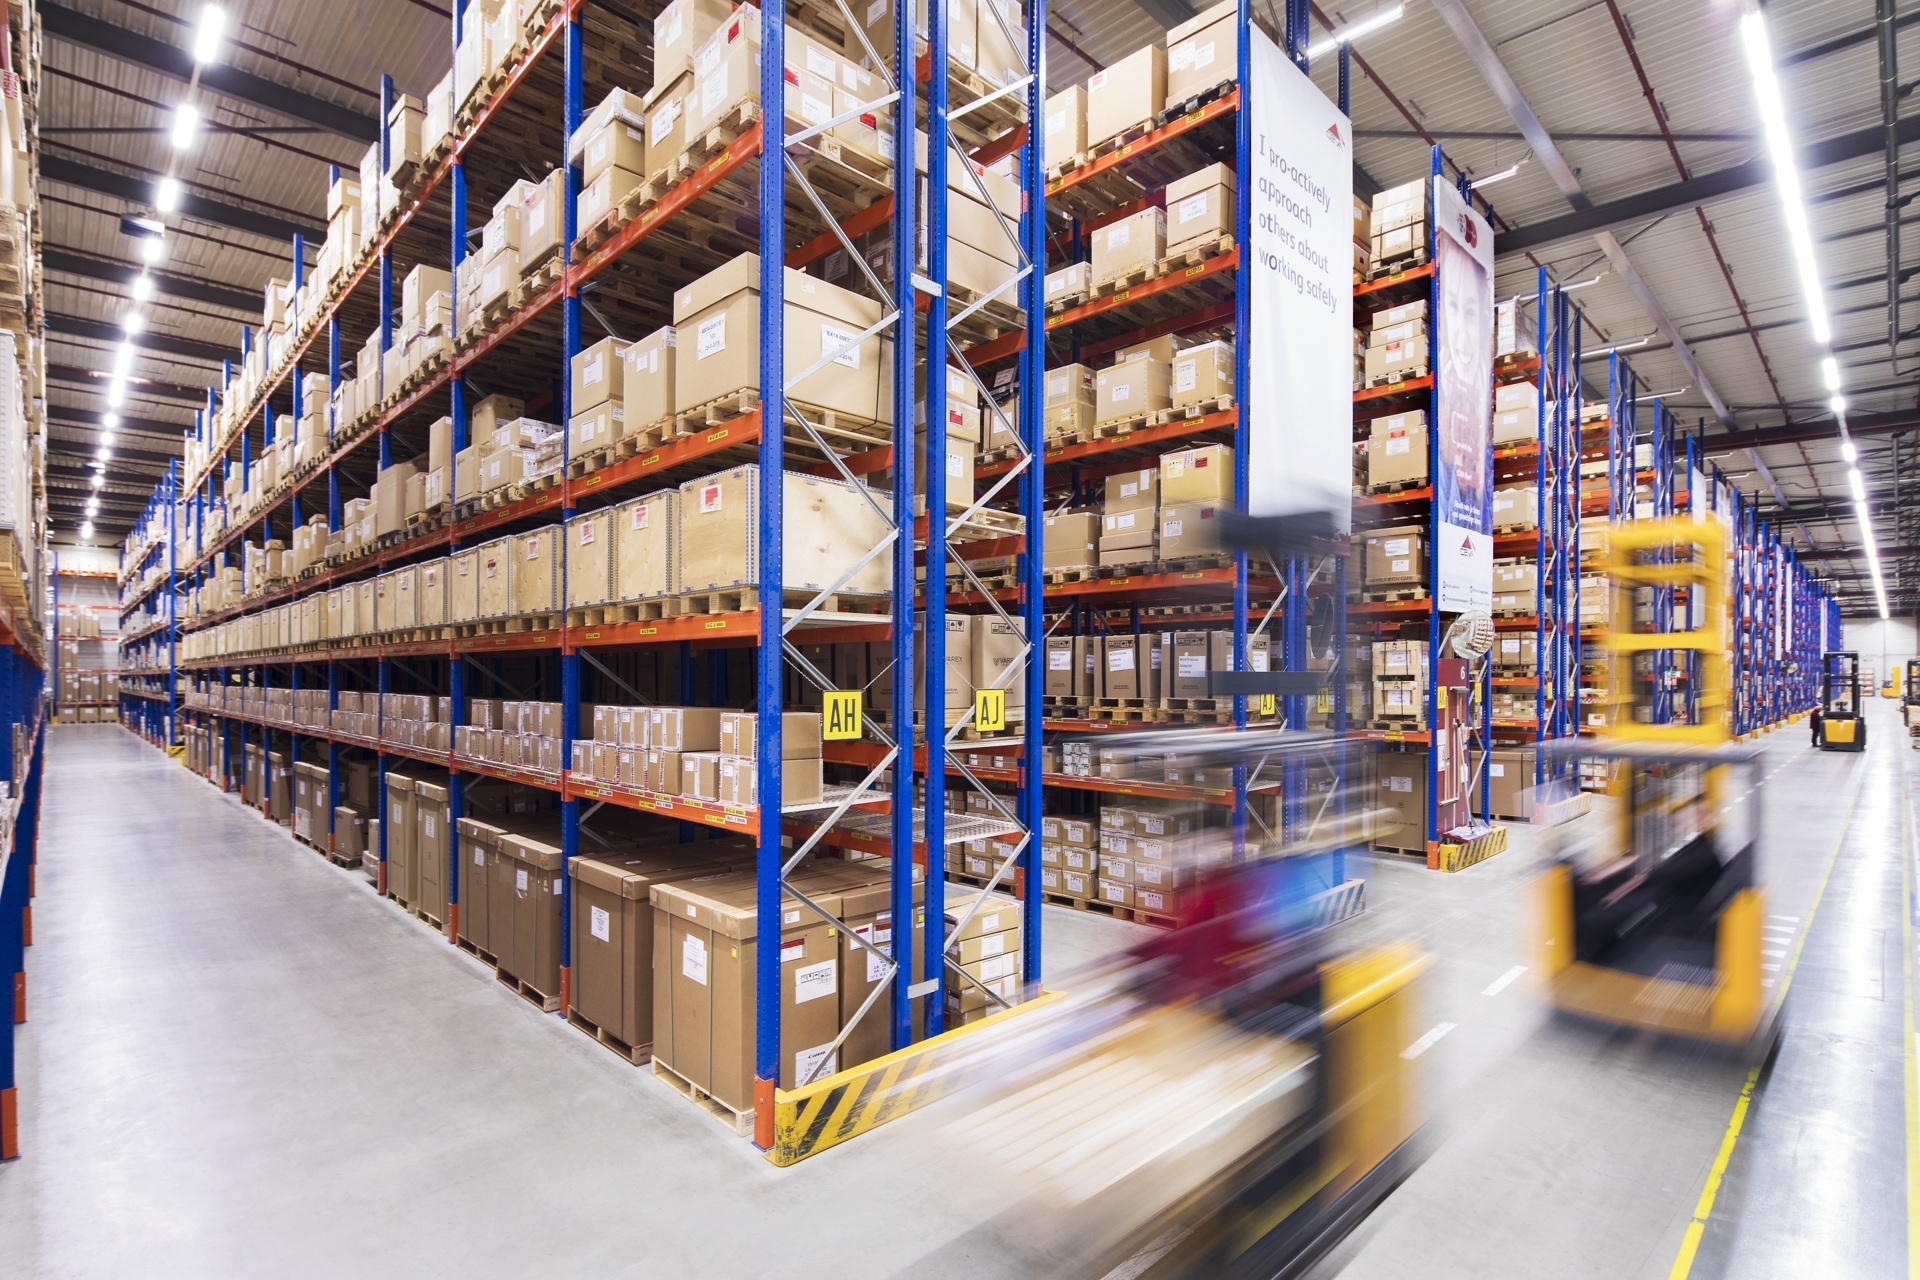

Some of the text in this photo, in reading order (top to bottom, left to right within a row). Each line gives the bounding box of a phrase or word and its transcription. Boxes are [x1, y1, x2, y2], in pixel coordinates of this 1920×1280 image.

[1259, 134, 1331, 213] I pro-actively
[1258, 176, 1312, 228] approach
[1258, 213, 1329, 274] others about
[1258, 248, 1337, 314] working safely
[1460, 666, 1466, 680] 6
[829, 698, 856, 733] AH
[980, 695, 1000, 726] AJ
